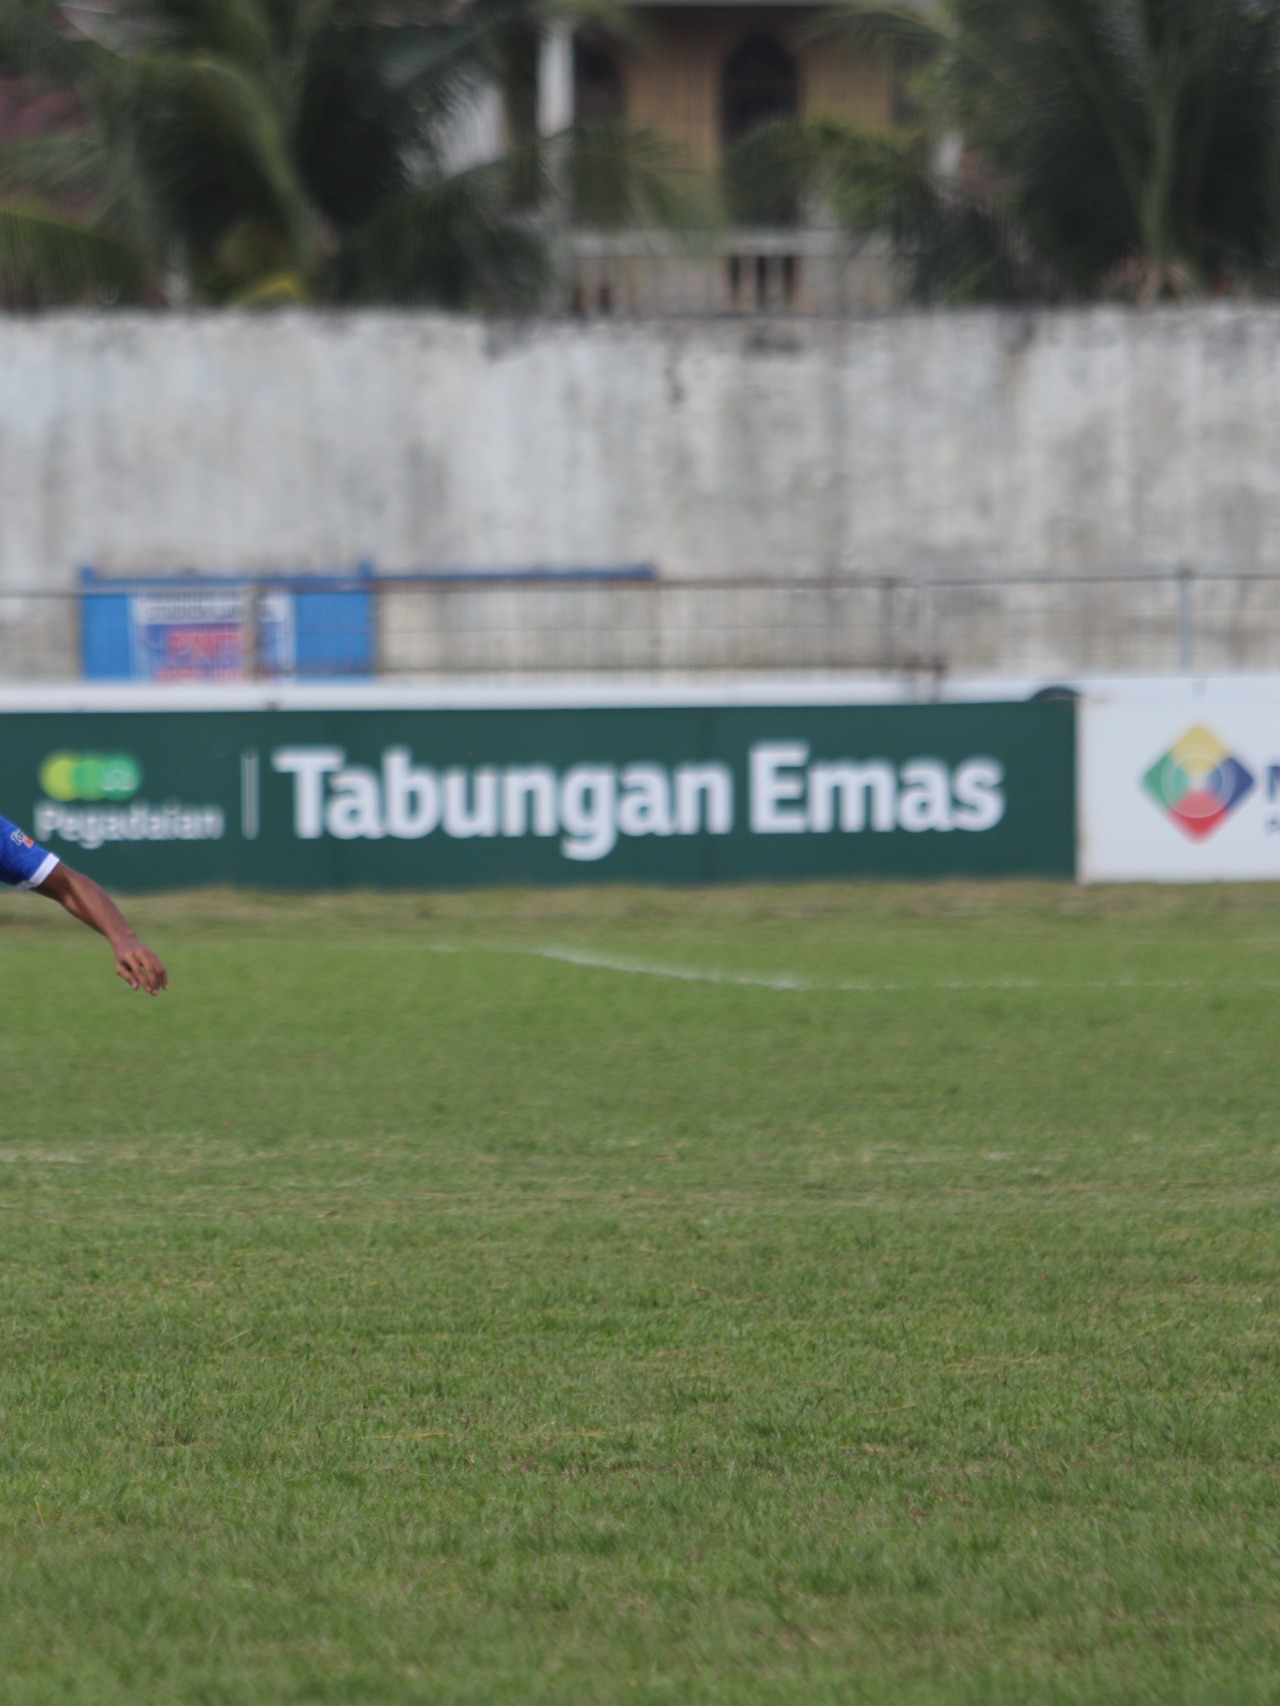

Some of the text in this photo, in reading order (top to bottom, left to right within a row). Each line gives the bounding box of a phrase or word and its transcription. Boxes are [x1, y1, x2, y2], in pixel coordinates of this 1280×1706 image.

[32, 801, 224, 849] Pegadaian
[272, 741, 1005, 860] Tabungan Emas
